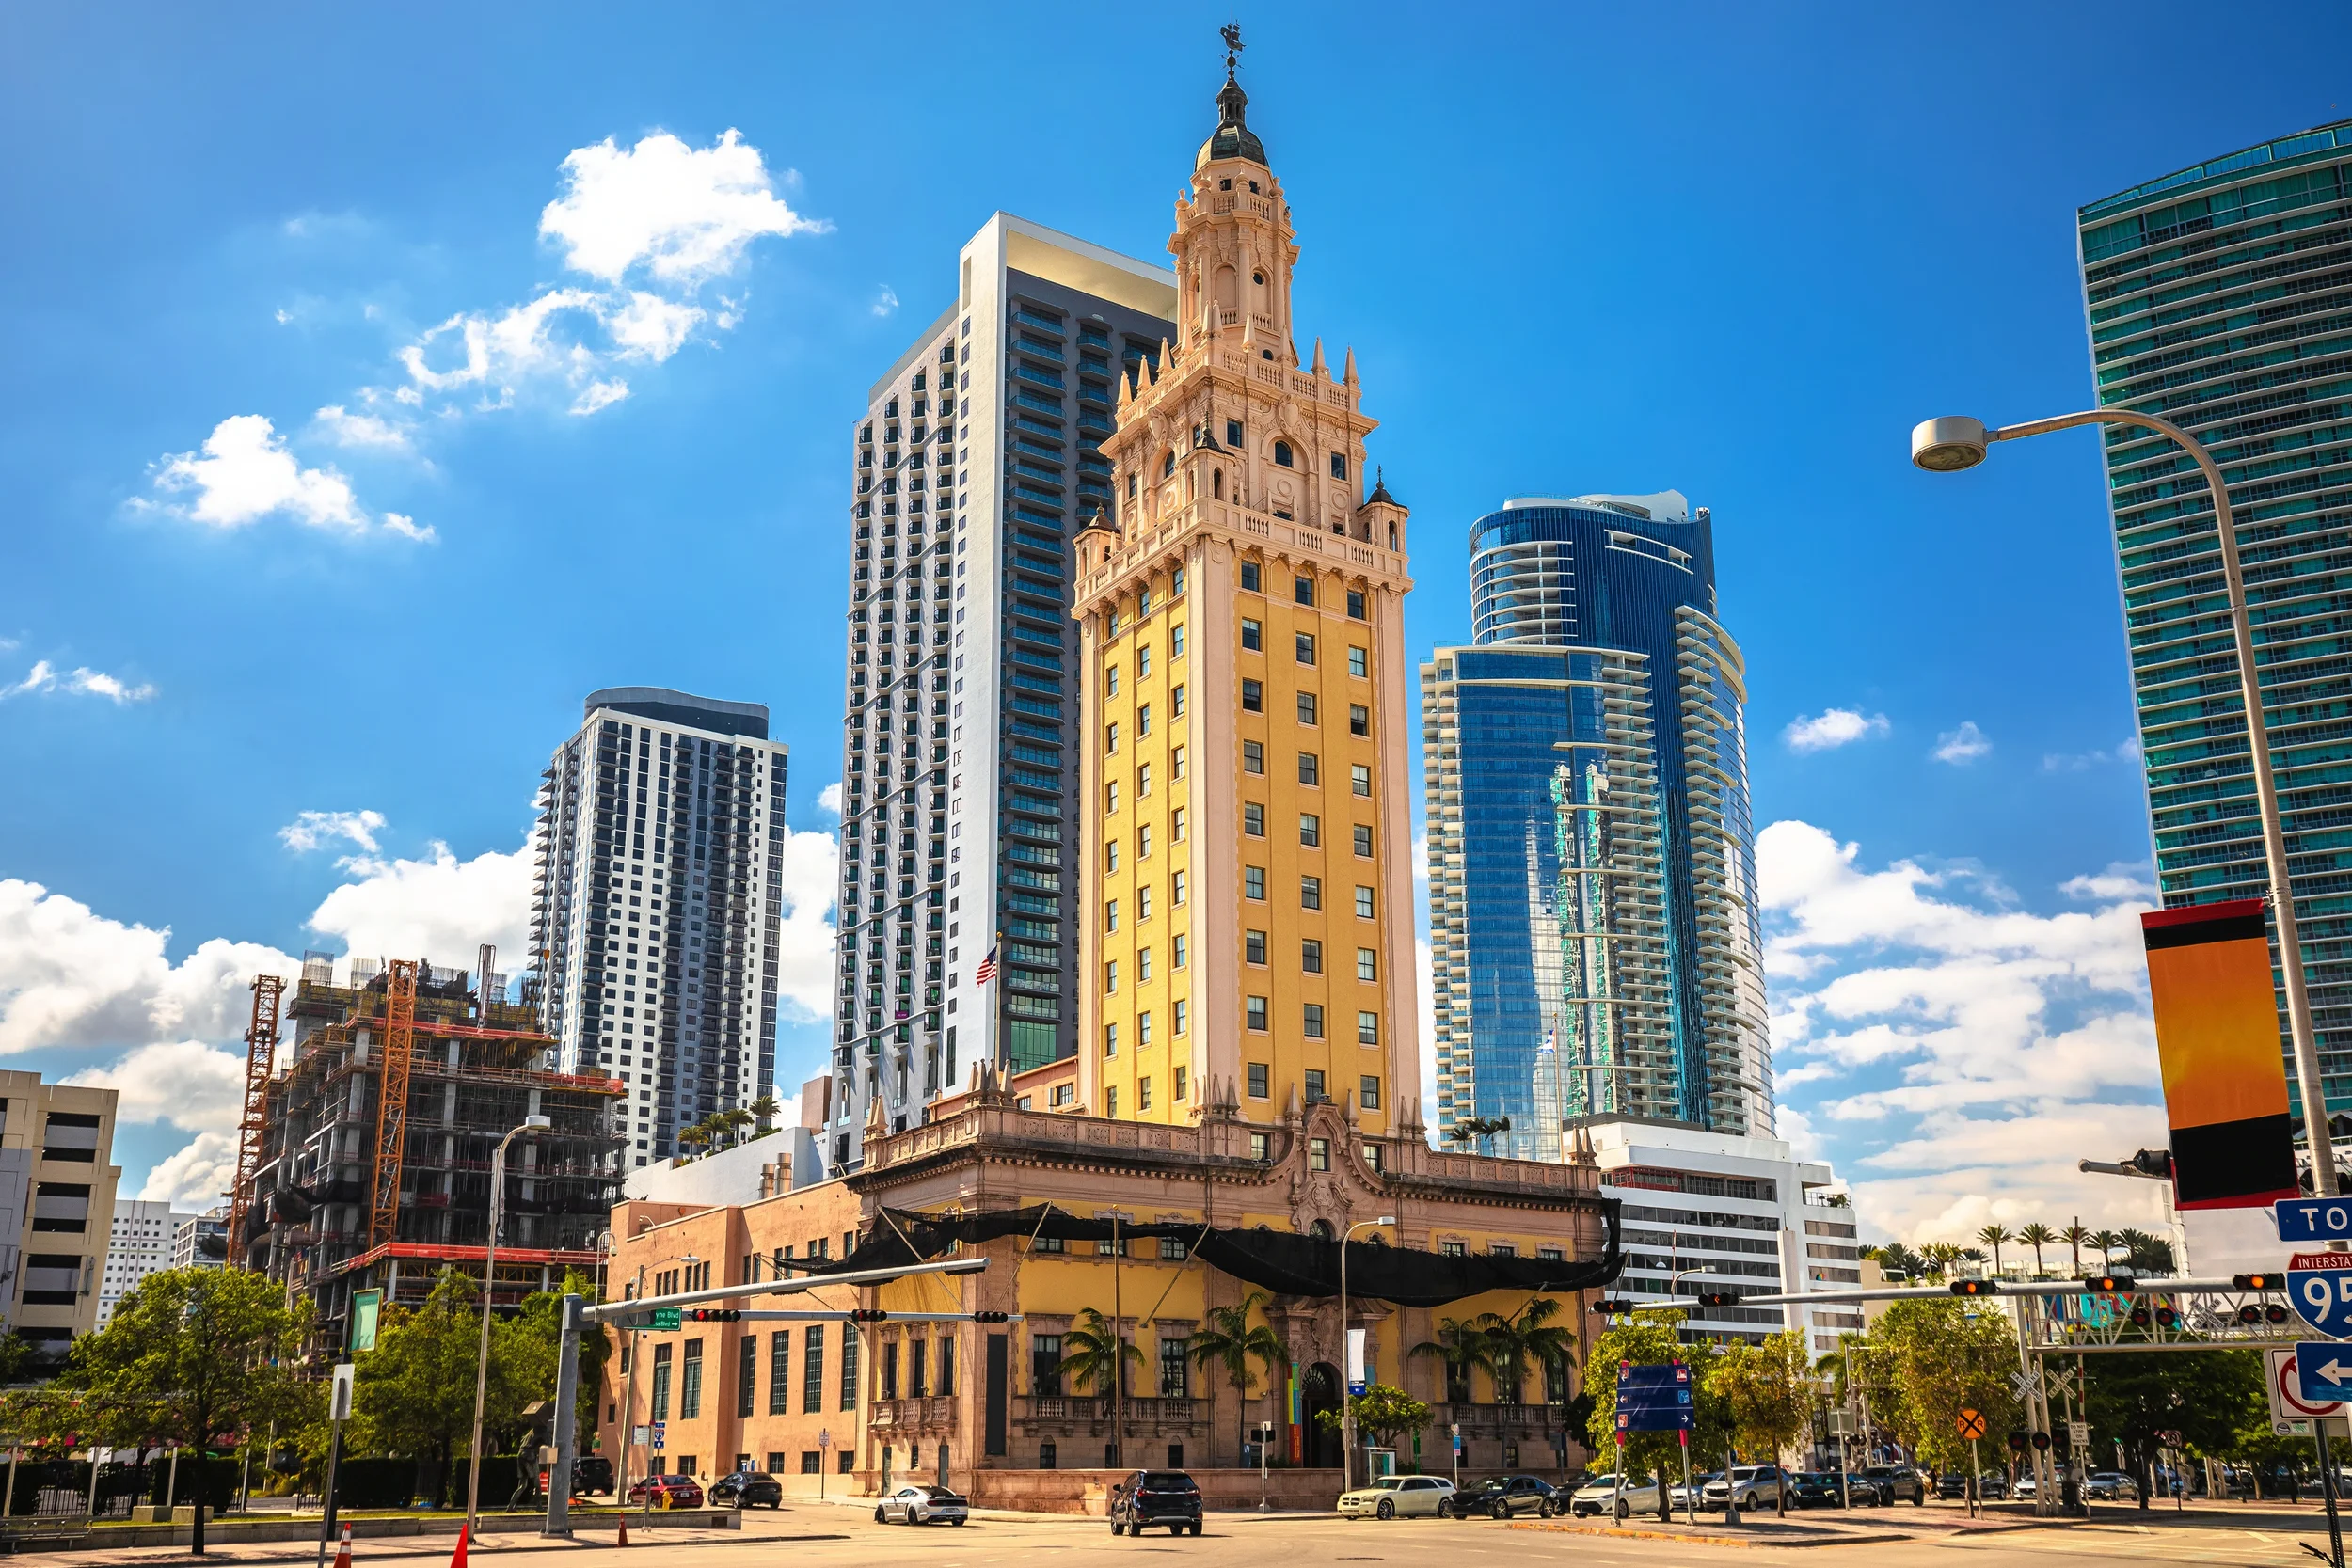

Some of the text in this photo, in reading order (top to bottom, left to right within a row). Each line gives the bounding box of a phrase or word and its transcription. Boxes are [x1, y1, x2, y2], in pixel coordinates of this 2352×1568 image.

[2299, 1207, 2348, 1232] TO
[2298, 1256, 2352, 1269] INTERSTA
[1959, 1420, 1965, 1429] R
